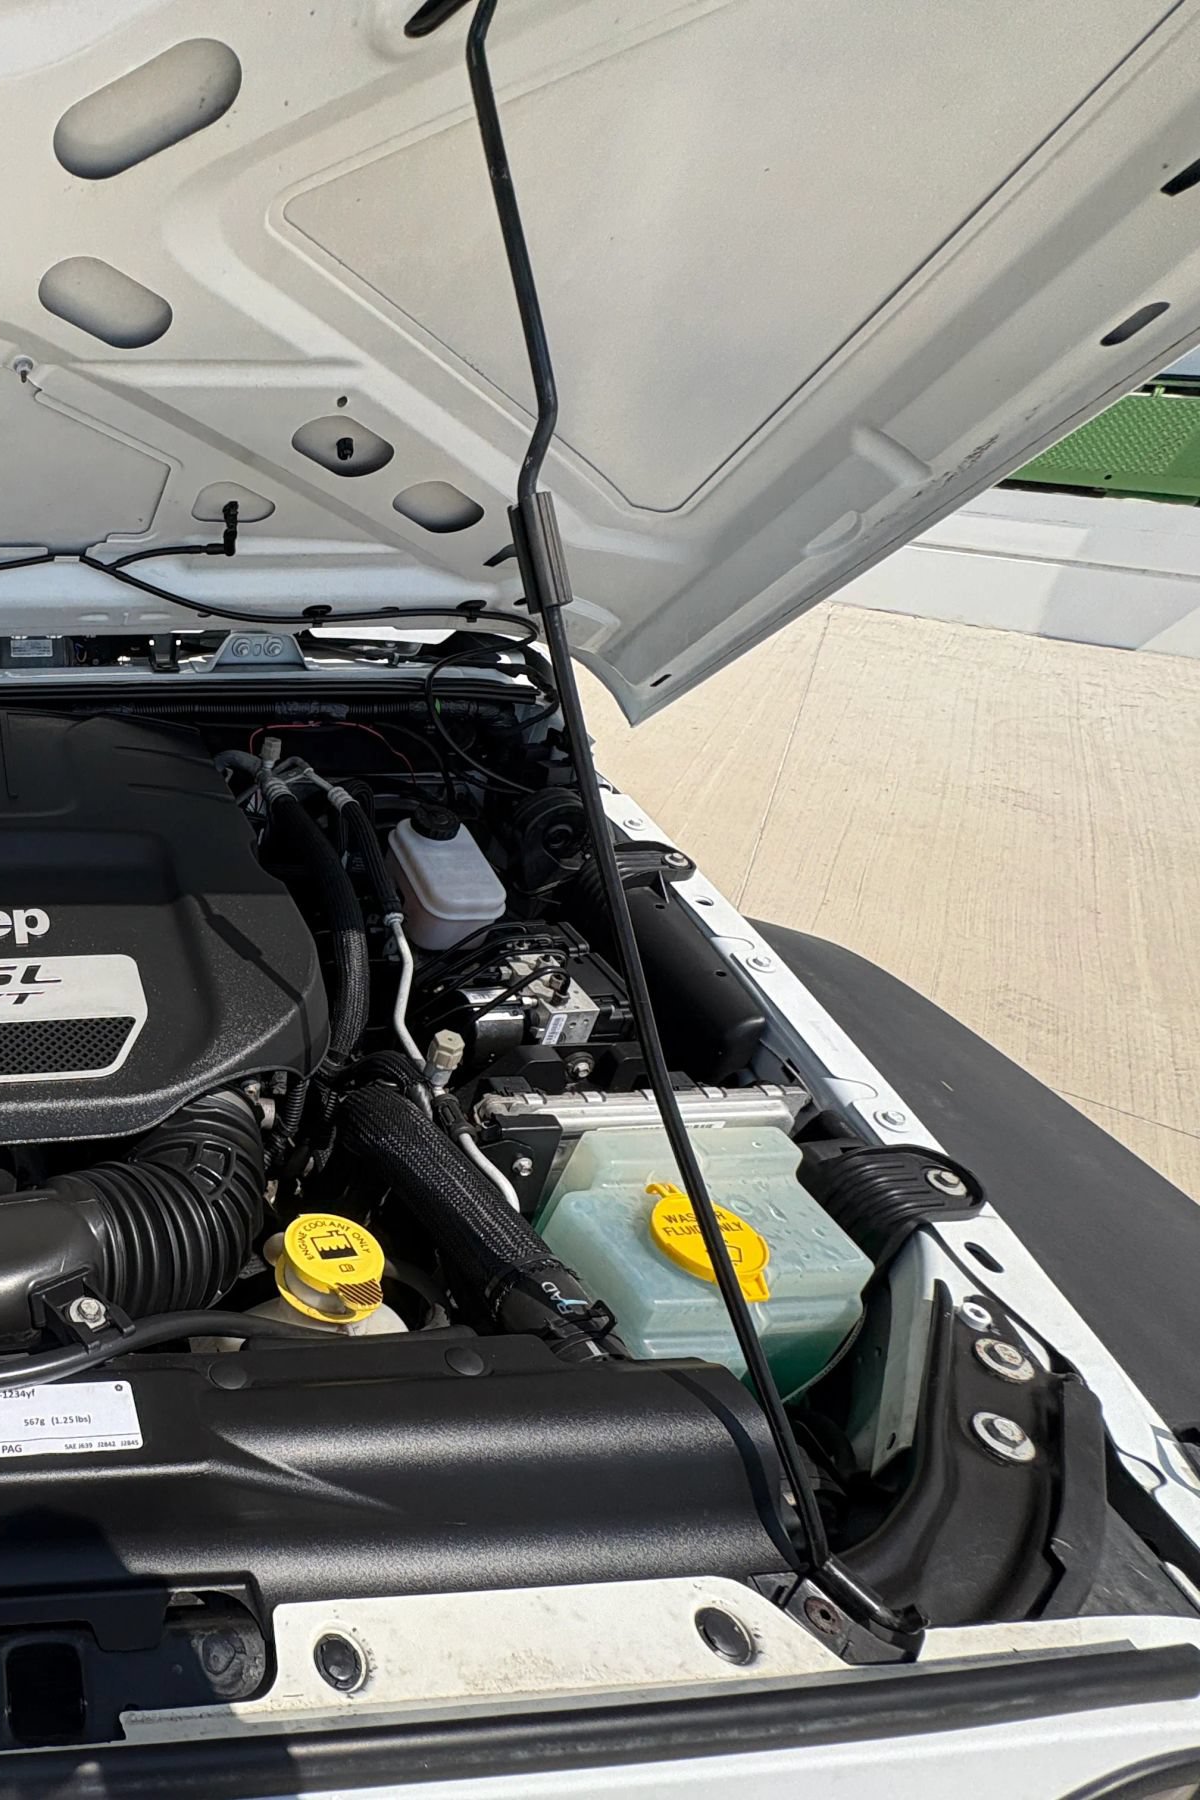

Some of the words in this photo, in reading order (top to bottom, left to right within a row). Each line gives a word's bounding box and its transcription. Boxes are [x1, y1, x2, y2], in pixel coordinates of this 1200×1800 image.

[663, 1211, 726, 1224] WASR
[303, 1220, 351, 1232] COOLANT
[718, 1221, 744, 1232] NLY
[297, 1231, 315, 1261] ENGINE
[352, 1232, 372, 1254] ONLY
[24, 1417, 46, 1427] 567g
[51, 1415, 74, 1426] (1.25
[75, 1414, 92, 1425] lbs)
[2, 1444, 23, 1455] PAG
